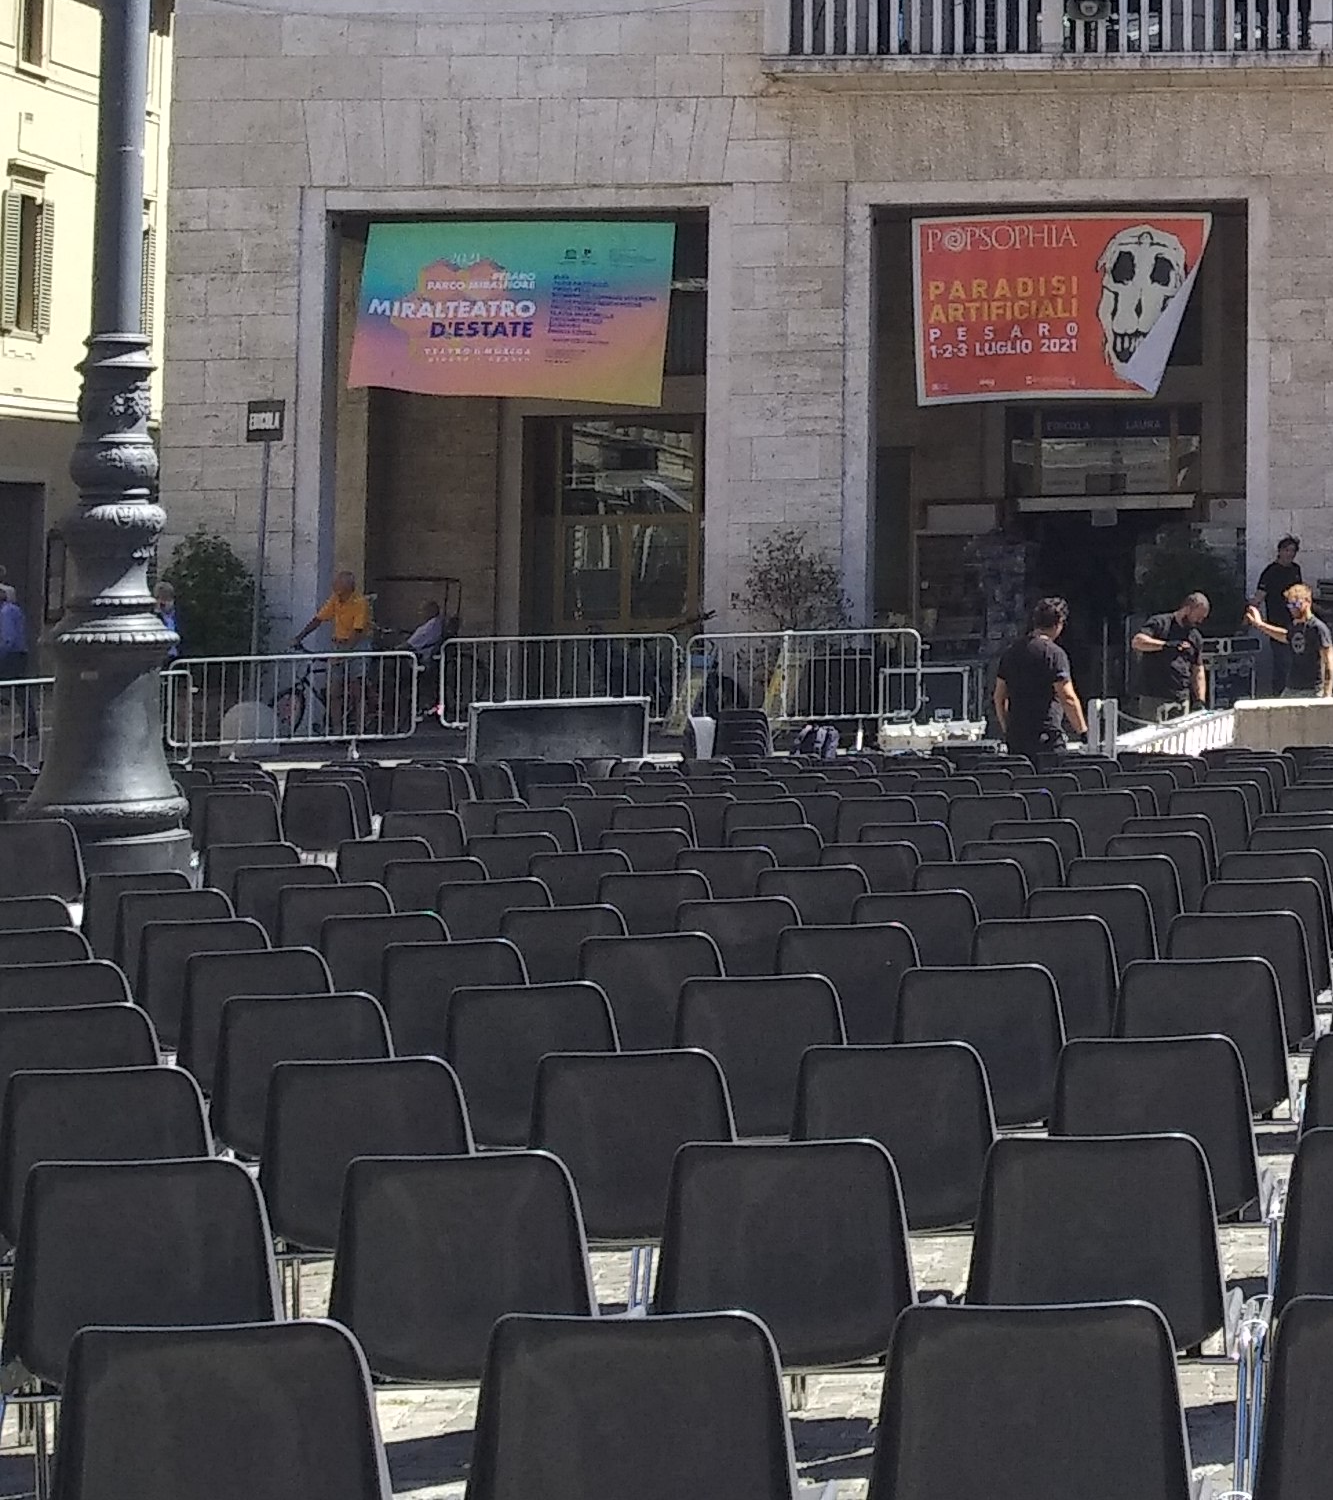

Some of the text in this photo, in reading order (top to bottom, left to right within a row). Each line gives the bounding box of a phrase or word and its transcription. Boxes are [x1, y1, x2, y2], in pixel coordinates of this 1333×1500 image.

[427, 280, 466, 290] PARCO
[928, 275, 1078, 300] PARADISI
[368, 298, 537, 318] MIRALTEATRO
[928, 297, 1079, 324] ARTIFICIALI
[430, 321, 534, 338] D'ESTATE
[929, 322, 1079, 342] PESARO
[930, 338, 1078, 358] 1-2-3 LUGLIO 2021
